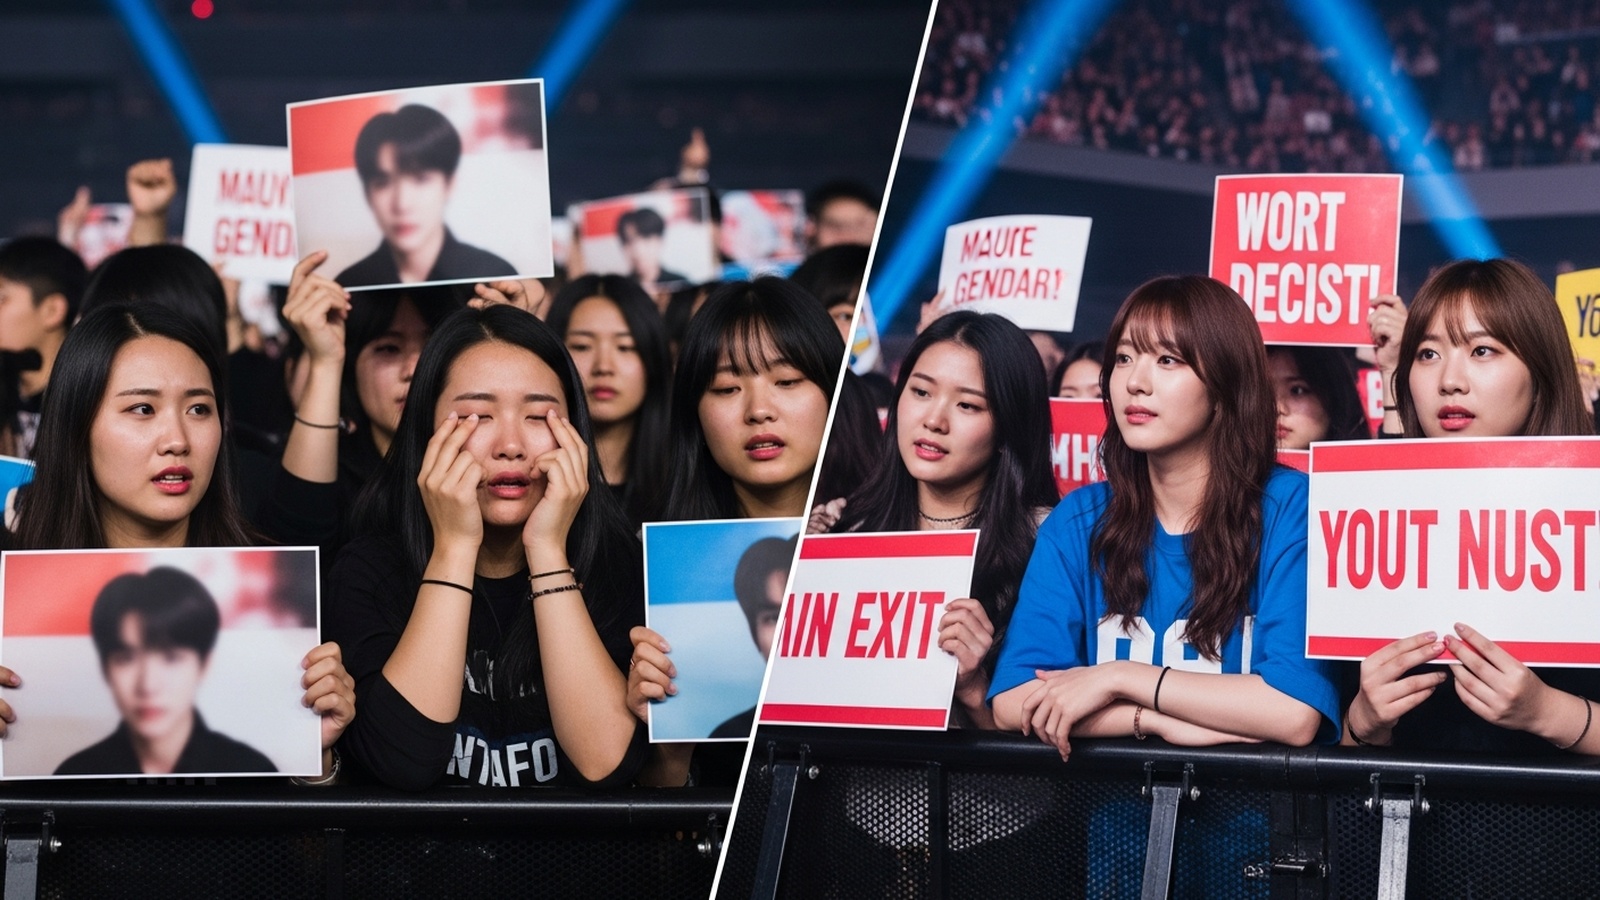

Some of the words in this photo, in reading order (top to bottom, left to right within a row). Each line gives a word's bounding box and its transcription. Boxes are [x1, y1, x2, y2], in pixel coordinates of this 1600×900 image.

[213, 217, 297, 257] GEND
[1236, 190, 1346, 252] WORT
[953, 267, 1064, 306] GENDAR!
[1229, 261, 1381, 325] DECIST!
[1319, 508, 1438, 590] YOUT
[1457, 508, 1600, 593] NUST
[844, 591, 946, 660] EXIT
